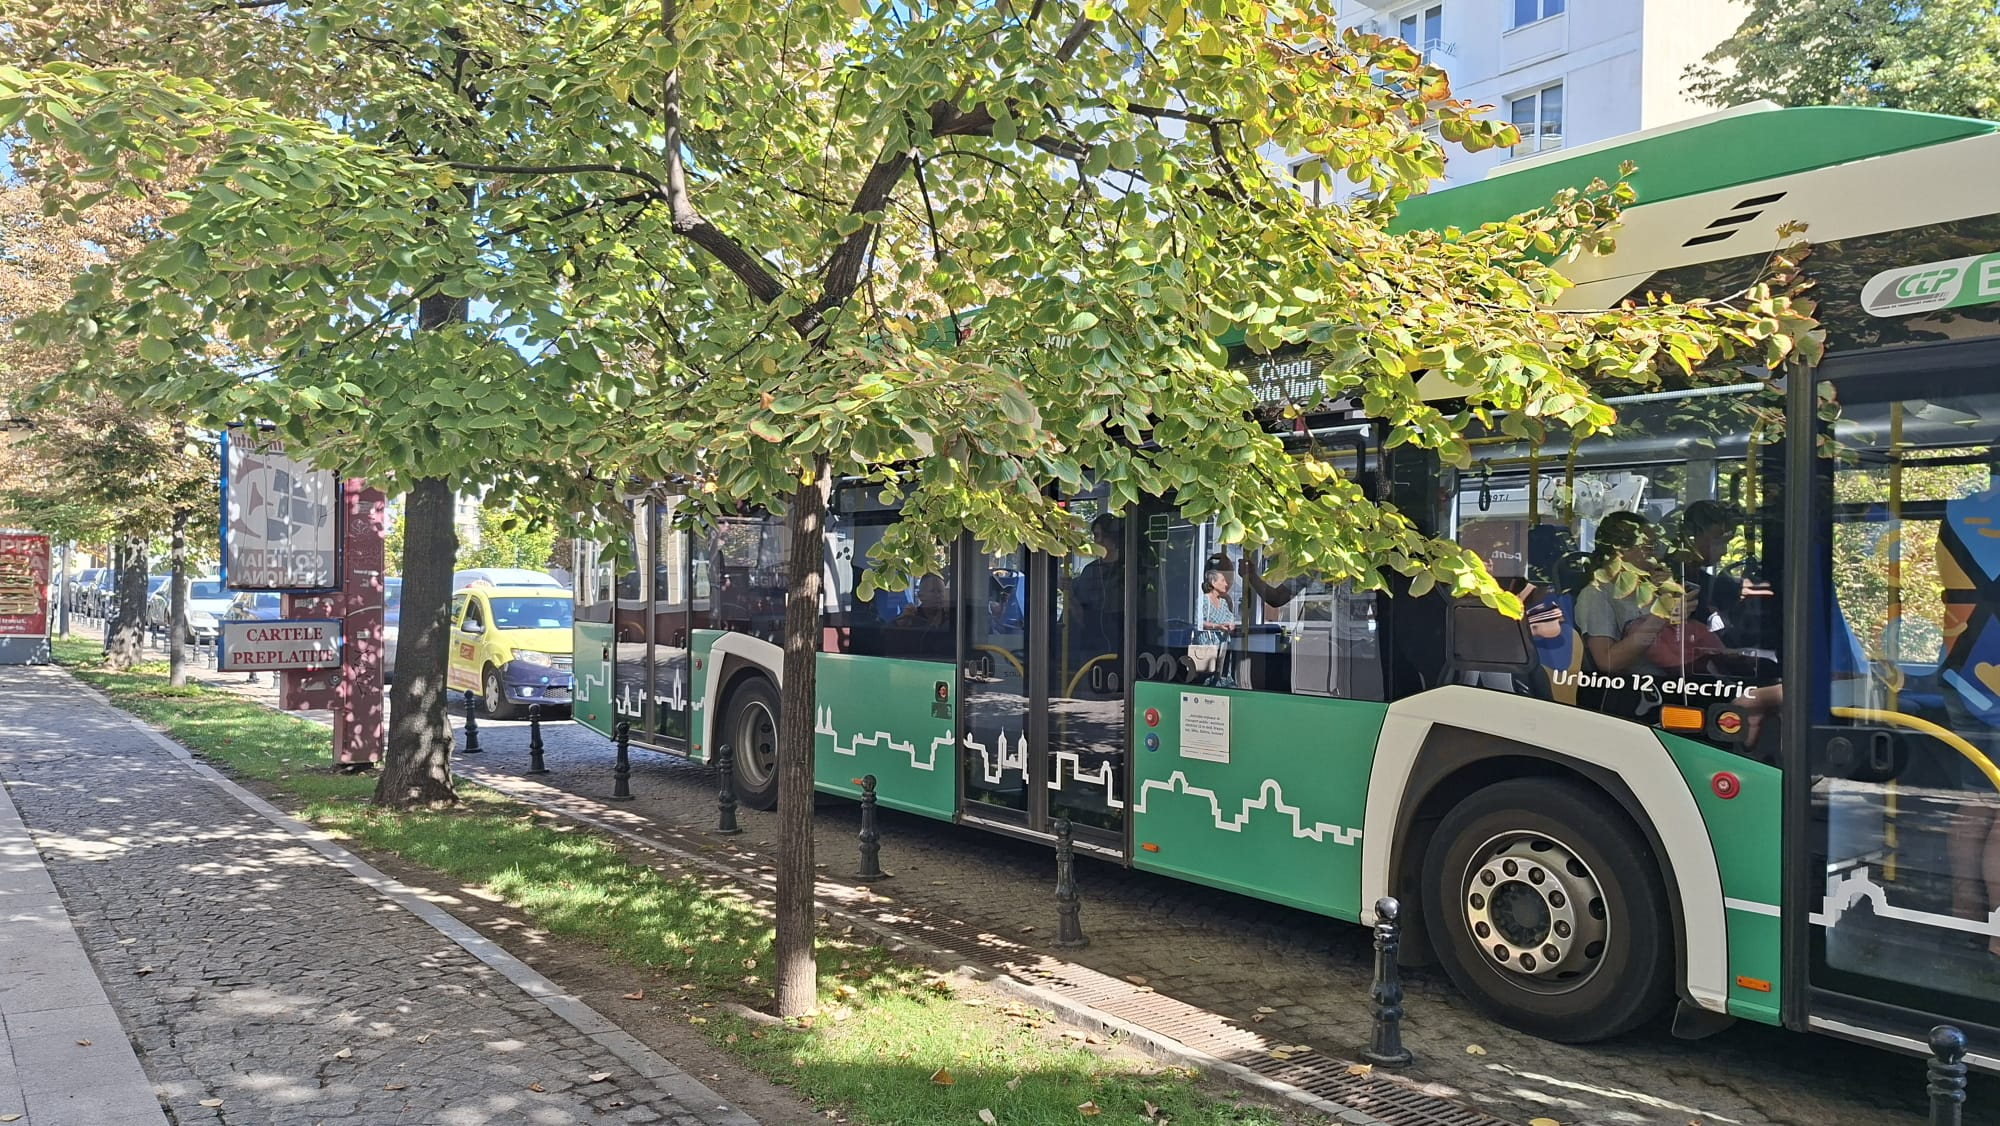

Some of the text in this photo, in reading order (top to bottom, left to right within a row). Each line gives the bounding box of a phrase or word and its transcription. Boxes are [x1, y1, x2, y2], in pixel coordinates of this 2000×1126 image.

[1896, 267, 1958, 297] CTP
[246, 627, 323, 642] CARTELE
[232, 649, 334, 665] PREPLATITE
[1553, 670, 1758, 699] Urbino 12 electric
